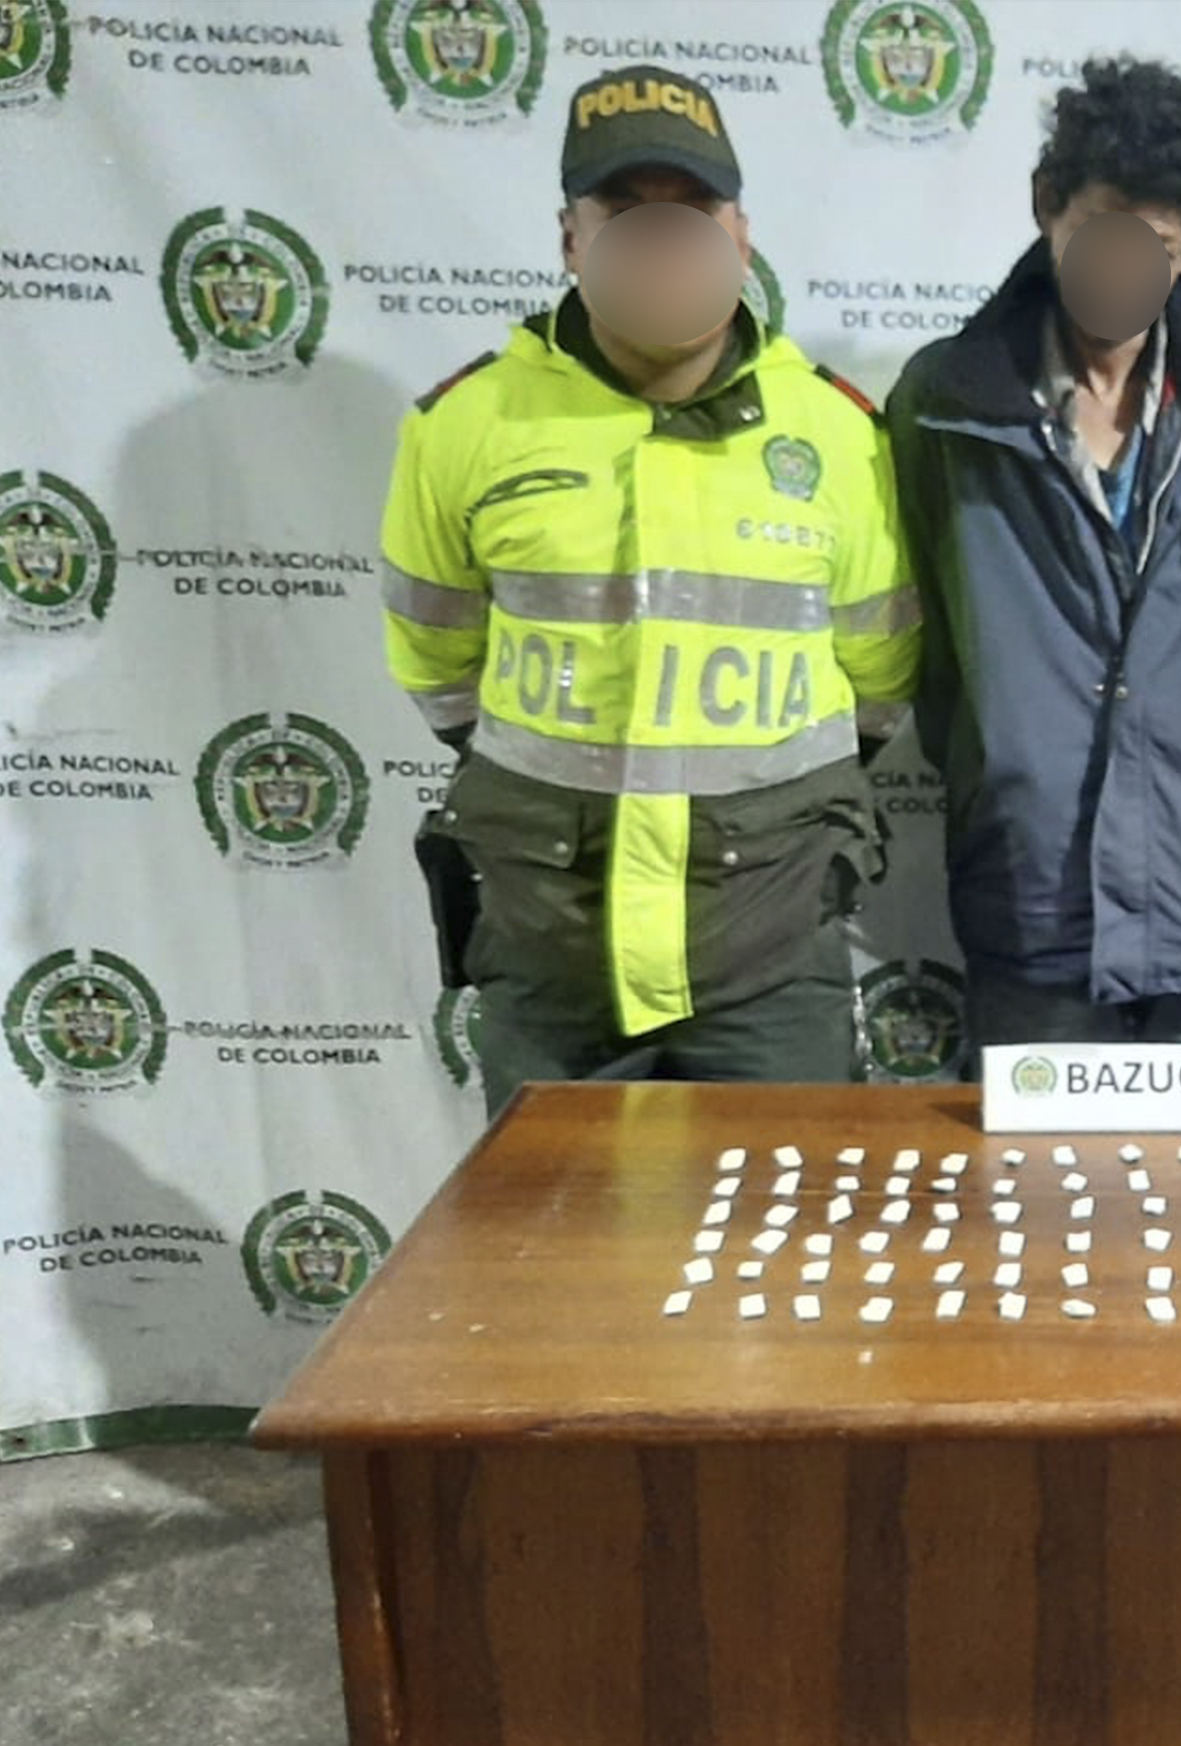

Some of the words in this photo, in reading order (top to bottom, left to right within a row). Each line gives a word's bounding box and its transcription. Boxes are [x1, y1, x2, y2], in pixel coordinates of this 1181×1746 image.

[207, 25, 345, 47] NACIONAL
[128, 49, 164, 70] DE
[173, 54, 311, 76] COLOMBIA
[674, 40, 812, 65] NACIONAL
[696, 72, 779, 94] OMBIA
[577, 79, 718, 137] POLICIA
[2, 252, 145, 276] NACIONAL
[451, 269, 573, 288] NACIONA
[915, 284, 993, 301] NACIO
[379, 294, 411, 313] DE
[418, 296, 553, 317] COLOMBIA
[841, 309, 873, 328] DE
[880, 312, 970, 329] COLOM
[250, 552, 374, 574] NACIONAL
[174, 577, 207, 595] DE
[217, 577, 347, 598] COLOMBIA
[59, 754, 181, 776] NACIONAL
[383, 760, 455, 778] POLIC
[29, 780, 154, 800] COLOMBIA
[417, 787, 447, 803] DE
[281, 1023, 412, 1040] NACIONAL
[217, 1046, 247, 1063] DE
[252, 1047, 382, 1065] COLOMBIA
[112, 1223, 227, 1244] NACIONAL
[39, 1254, 71, 1272] DE
[79, 1246, 203, 1267] COLOMBIA
